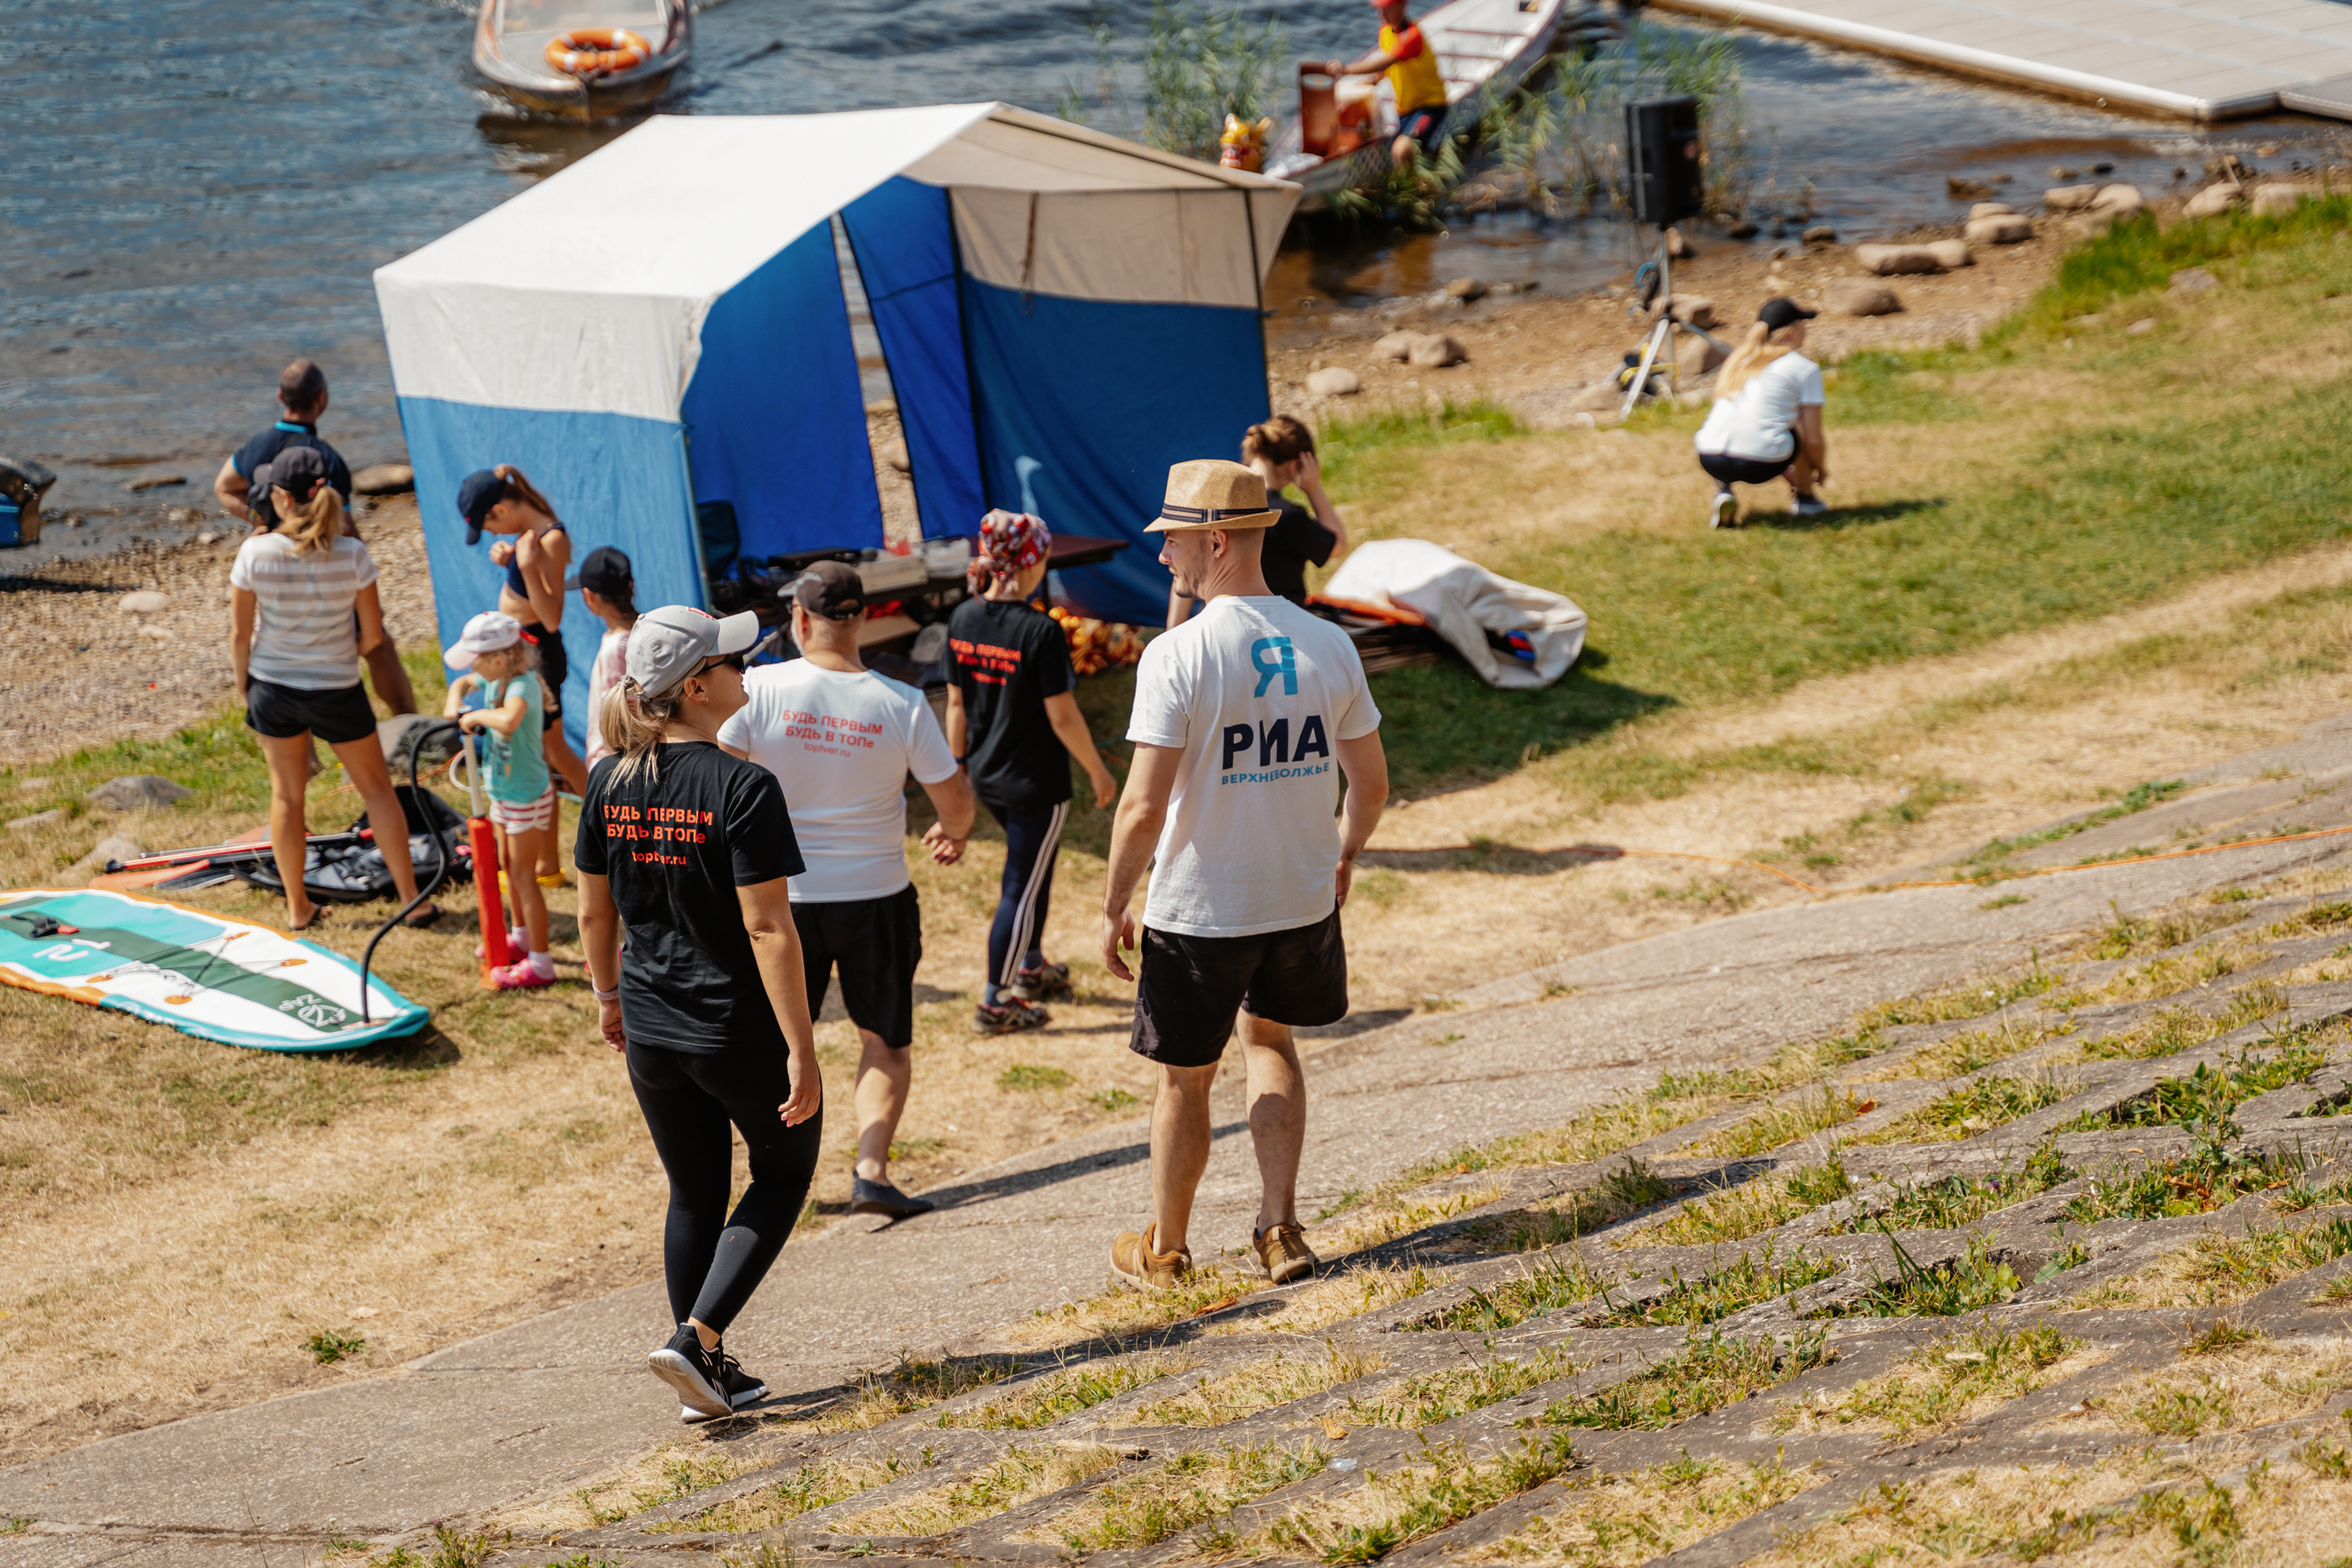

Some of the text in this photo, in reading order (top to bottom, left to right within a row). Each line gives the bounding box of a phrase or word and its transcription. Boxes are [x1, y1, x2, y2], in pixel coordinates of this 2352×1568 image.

[782, 709, 883, 735] БУДЬ ПЕРВЫМ
[785, 725, 874, 749] БУДЬ В ТОПе
[1222, 715, 1329, 770] РИА
[1221, 762, 1329, 785] ВЕРХНЕВОЛЖЬЕ
[647, 807, 713, 826] ПЕРВЫМ
[606, 823, 650, 840] БУДЬ
